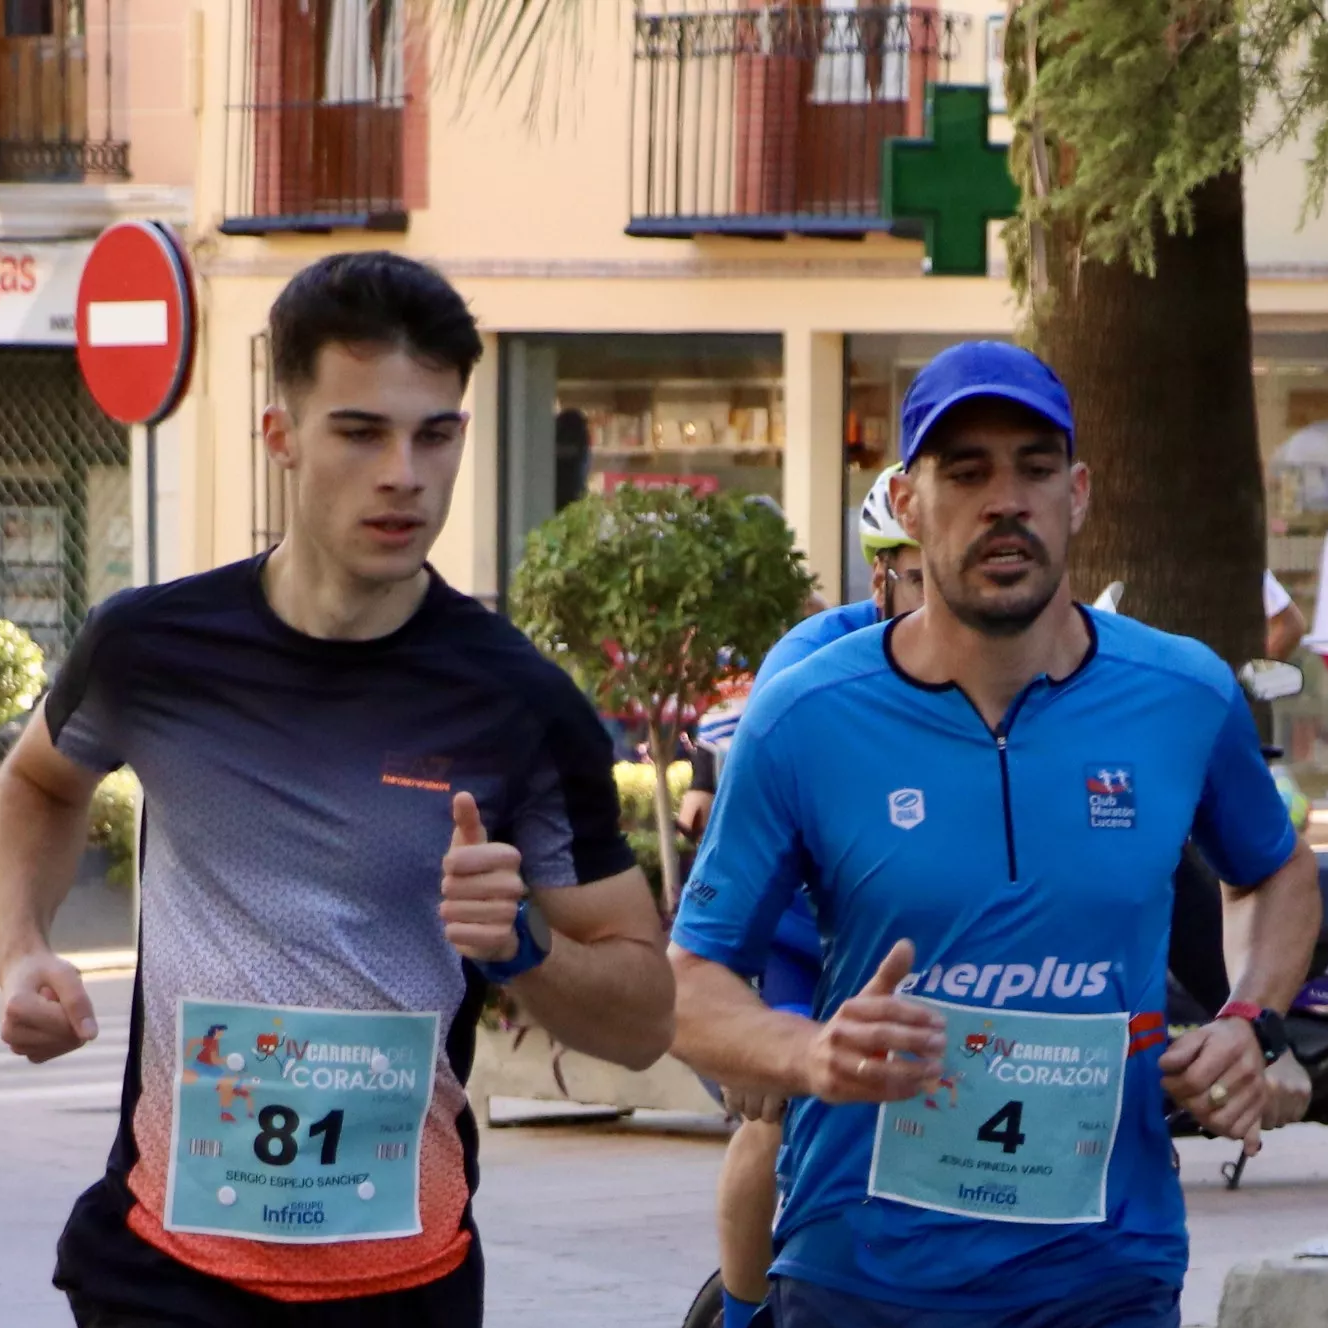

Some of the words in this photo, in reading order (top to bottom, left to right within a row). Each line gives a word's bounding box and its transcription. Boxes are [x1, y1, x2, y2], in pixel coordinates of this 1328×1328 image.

[1089, 794, 1117, 806] Club
[1091, 817, 1132, 828] Lucena
[306, 1043, 381, 1065] CARRERA
[1013, 1043, 1080, 1063] CARRERA
[254, 1104, 344, 1166] 81
[977, 1101, 1025, 1154] 4
[938, 1155, 973, 1168] JESUS
[976, 1160, 1017, 1173] PINEDA
[226, 1170, 267, 1185] SERGIO
[270, 1176, 314, 1188] ESPEJO
[317, 1173, 370, 1187] SANCHEZ
[958, 1183, 1017, 1205] Infrico
[263, 1205, 325, 1225] Infrico
[289, 1201, 323, 1210] GRUPO
